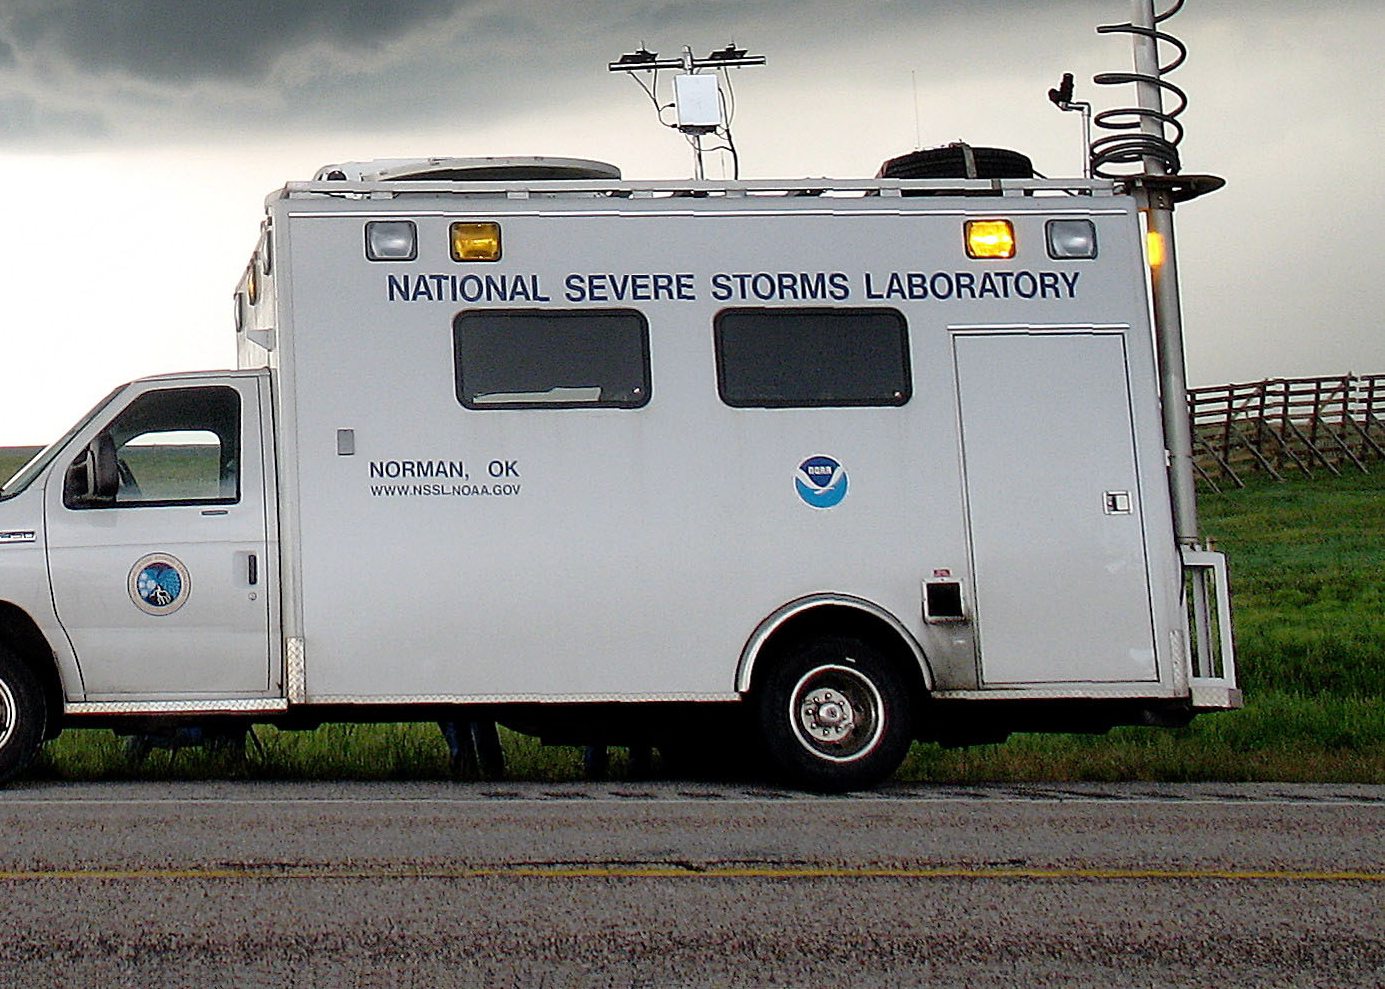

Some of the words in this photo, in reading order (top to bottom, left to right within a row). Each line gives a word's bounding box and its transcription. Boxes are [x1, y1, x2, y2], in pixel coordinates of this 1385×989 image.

[387, 274, 550, 302] NATIONAL
[564, 273, 696, 301] SEVERE
[711, 272, 850, 300] STORMS
[864, 271, 1080, 300] LABORATORY
[370, 461, 470, 480] NORMAN,
[487, 460, 520, 478] OK
[370, 484, 521, 497] WWW.NSSL.NOAA.GOV
